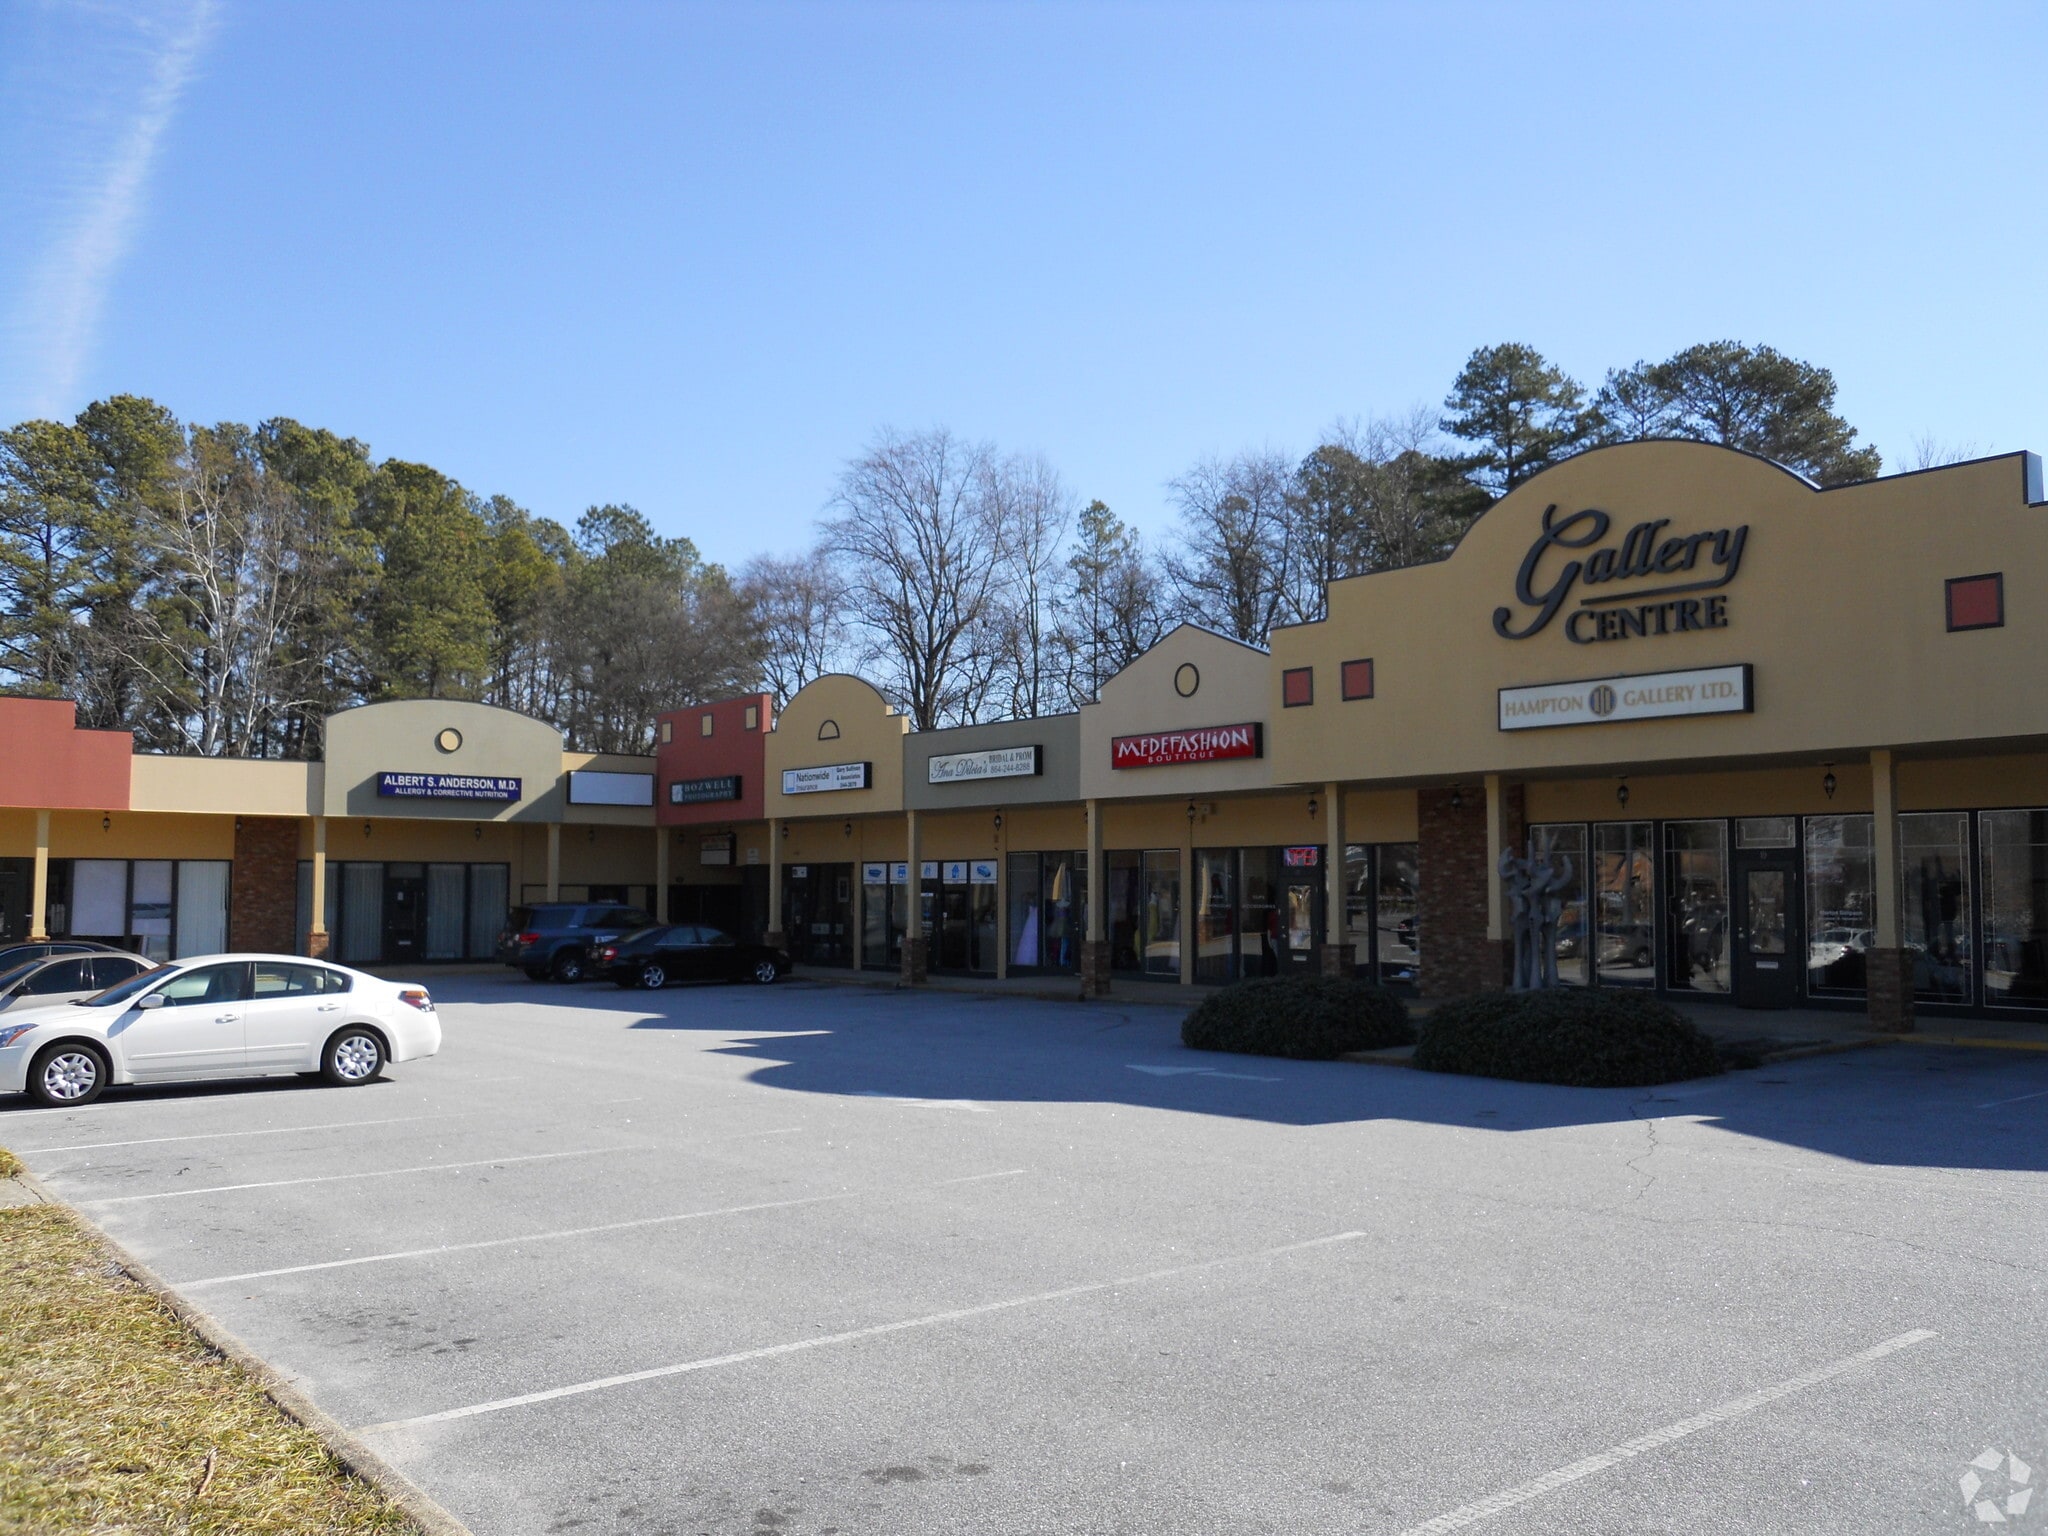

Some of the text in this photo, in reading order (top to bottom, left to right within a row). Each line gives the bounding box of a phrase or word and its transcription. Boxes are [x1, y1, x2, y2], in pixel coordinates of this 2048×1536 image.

[1492, 504, 1749, 640] Gallery
[1565, 595, 1728, 644] CENTRE
[1504, 696, 1583, 717] HAMPTON
[1623, 685, 1696, 707] GALLERY
[1701, 681, 1738, 700] LTD.
[989, 750, 1033, 764] BRIDAL & PROM
[1148, 751, 1215, 763] BOUTIQUE
[384, 775, 519, 791] ALBERT S. ANDERSON, M.D.
[796, 770, 830, 782] Nationwide
[394, 787, 426, 795] ALLERGY
[433, 789, 474, 797] CORRECTIVE
[474, 790, 508, 798] NUTRITION
[684, 779, 732, 792] BOZWELL
[1286, 848, 1318, 867] OPEN
